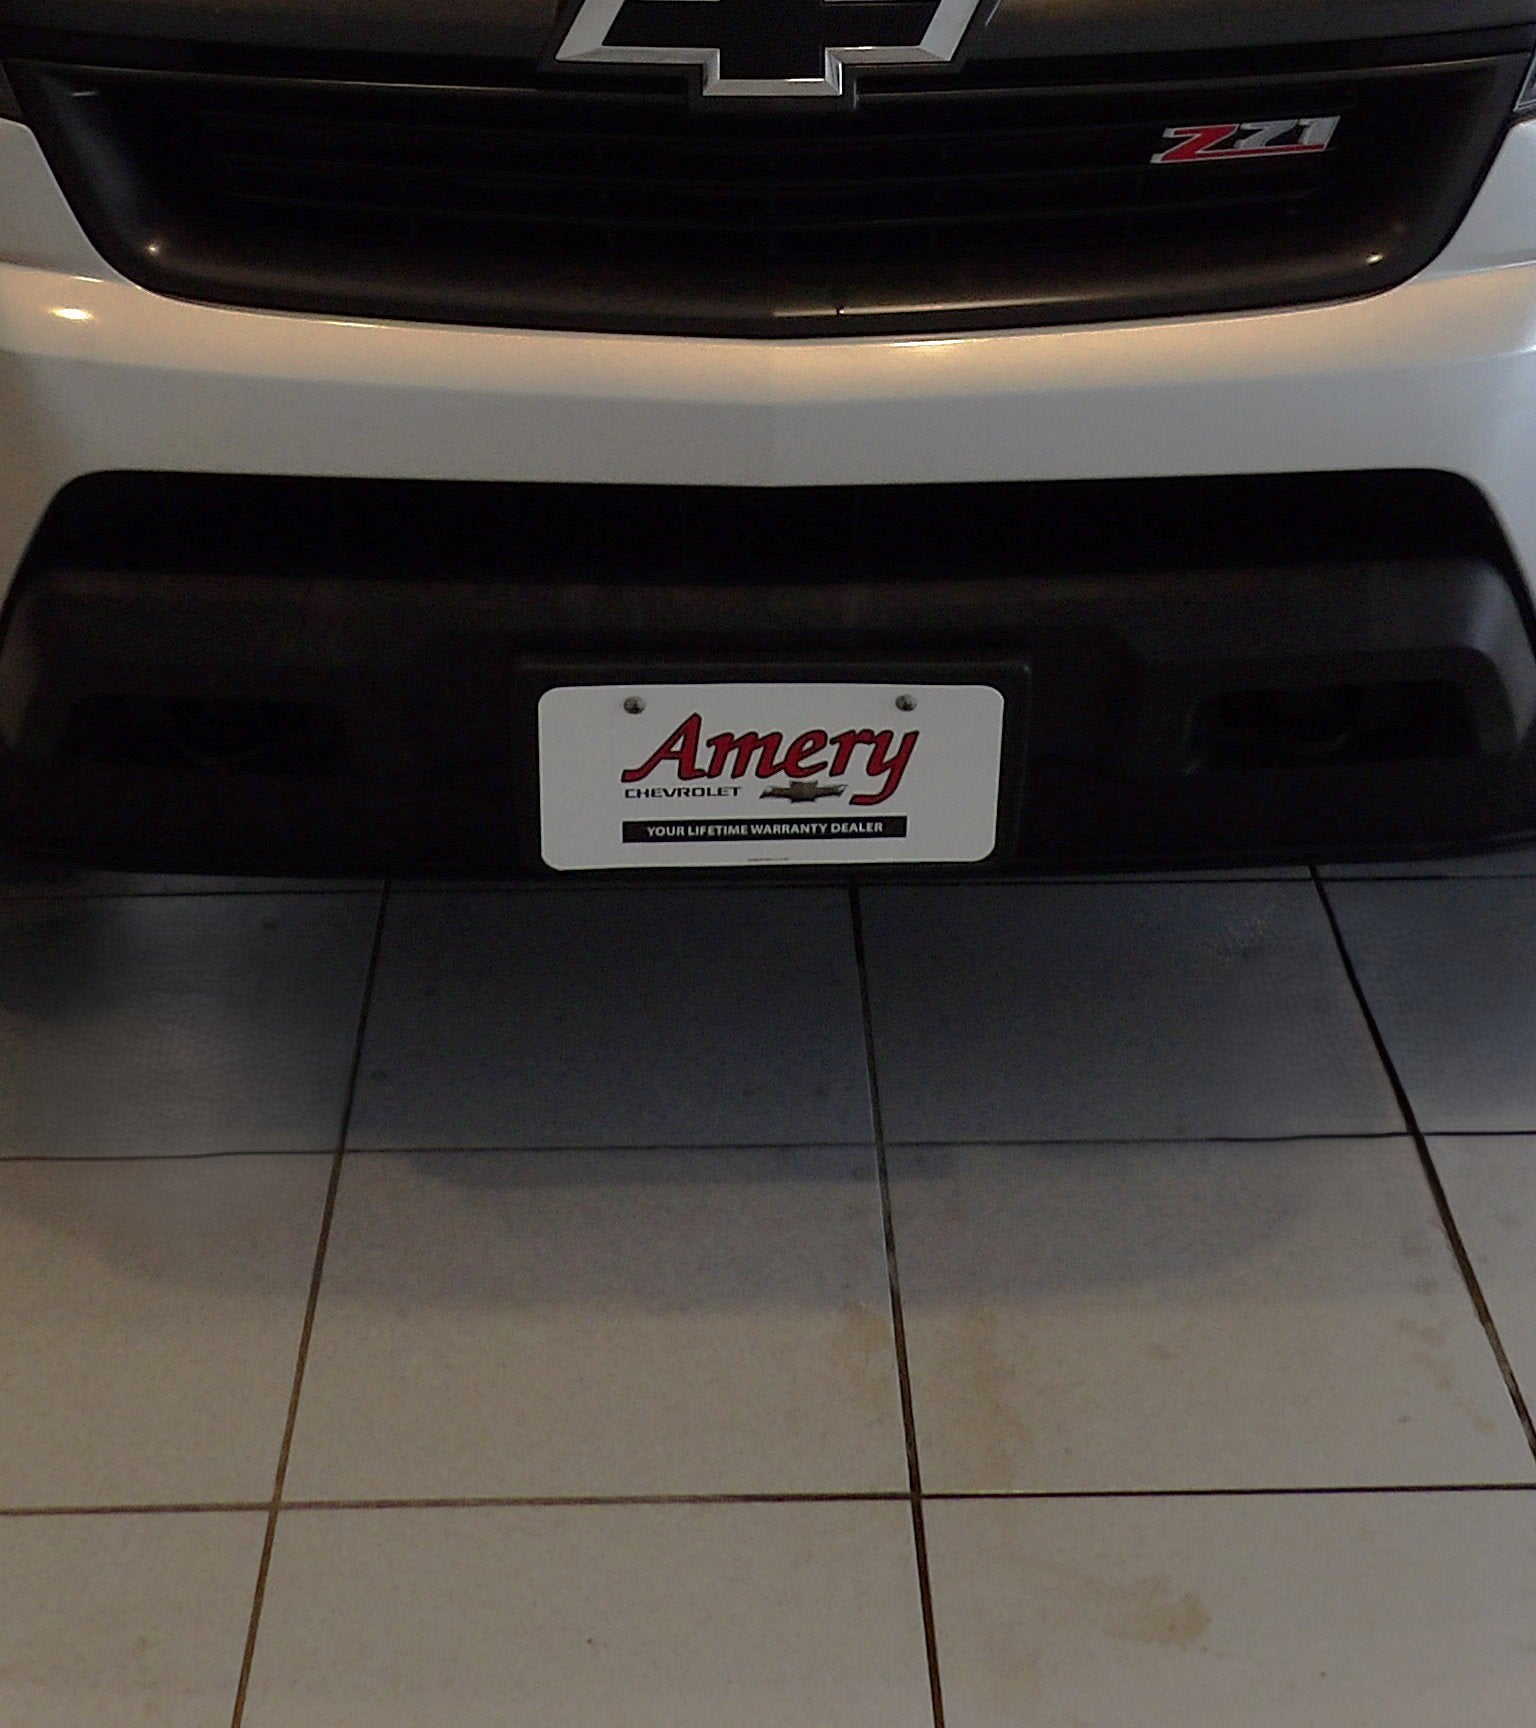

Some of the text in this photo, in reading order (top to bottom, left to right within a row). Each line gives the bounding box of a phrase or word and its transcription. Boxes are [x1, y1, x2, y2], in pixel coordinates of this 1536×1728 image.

[1150, 115, 1341, 164] Z71
[620, 712, 920, 806] Amery
[624, 786, 742, 799] CHEVROLET
[646, 822, 883, 837] YOUR LIFETIME WARRANTY DEALER
